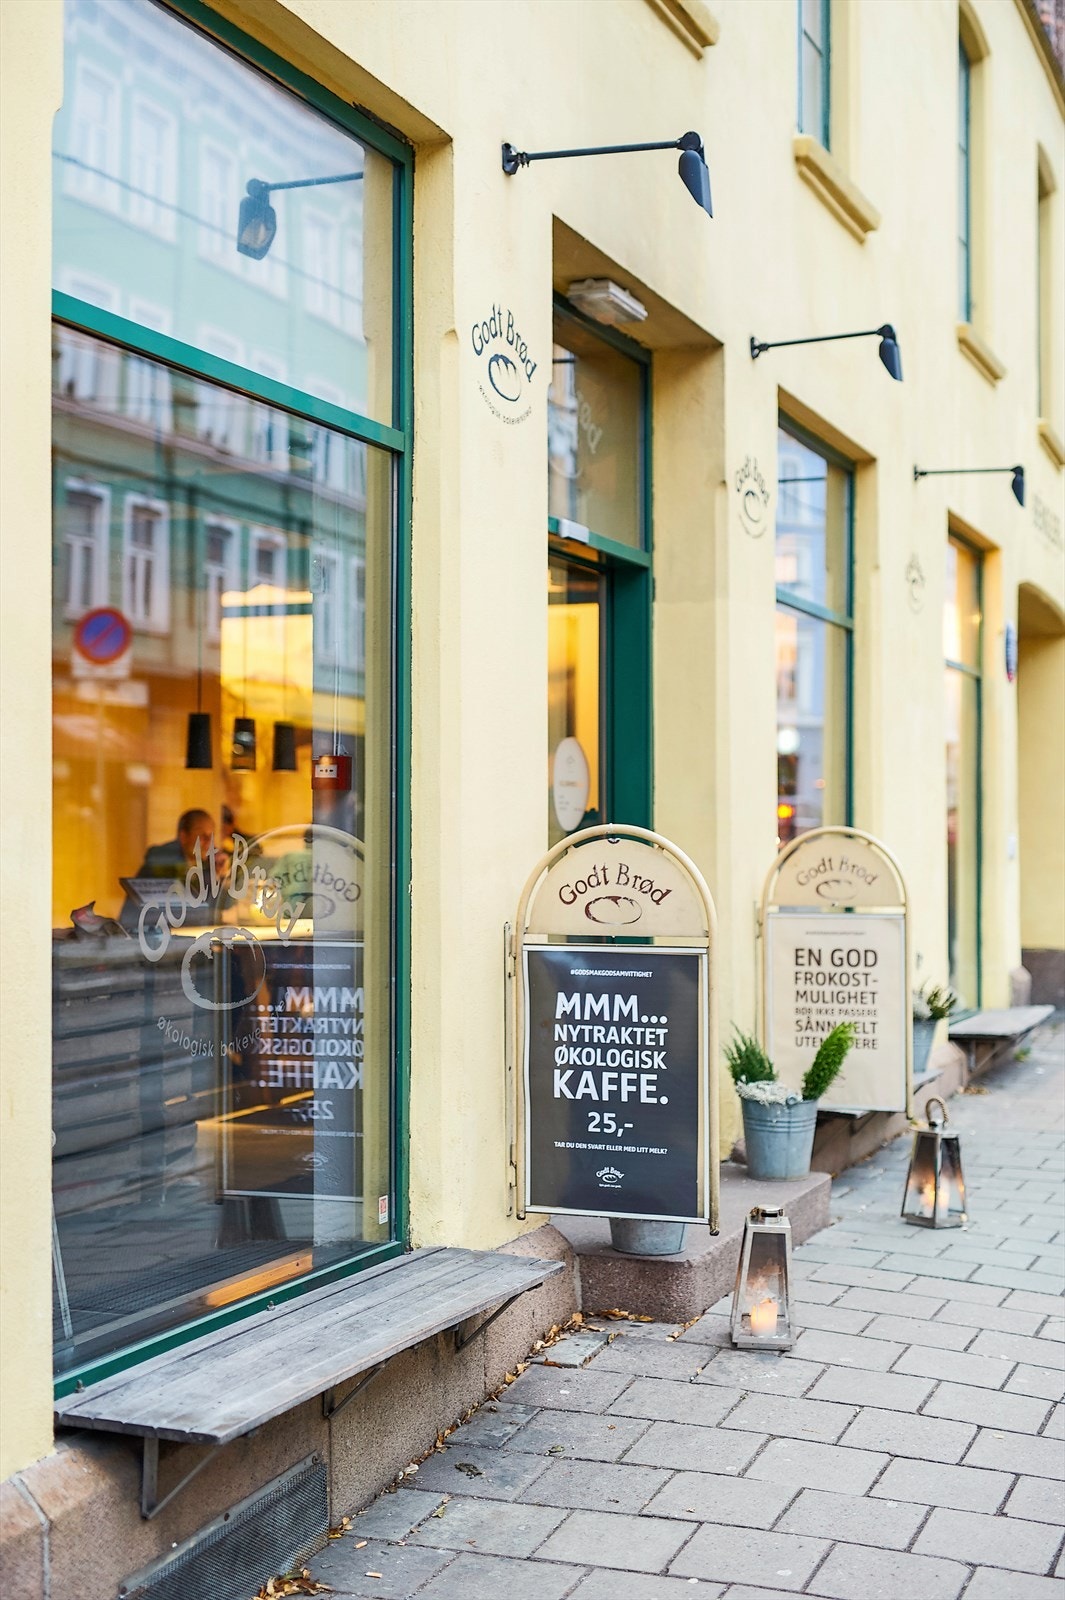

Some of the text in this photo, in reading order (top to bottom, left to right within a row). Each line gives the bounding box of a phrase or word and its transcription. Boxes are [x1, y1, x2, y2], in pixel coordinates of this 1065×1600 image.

[472, 302, 537, 383] Godt Brød
[138, 832, 306, 962] Godt Brød
[558, 862, 673, 906] Godt Brød
[794, 948, 878, 968] EN GOD
[794, 971, 879, 987] FROKOST-
[555, 992, 668, 1024] MMM...
[795, 990, 878, 1005] MULIGHET
[156, 1016, 214, 1057] økologisk
[554, 1023, 669, 1046] NYTRAKTET
[554, 1044, 668, 1070] ØKOLOGISK
[553, 1069, 669, 1105] KAFFE.
[587, 1111, 634, 1137] 25,-
[554, 1141, 566, 1149] TAR
[587, 1143, 606, 1151] SVART
[623, 1145, 636, 1153] MED
[648, 1147, 668, 1155] MELK?
